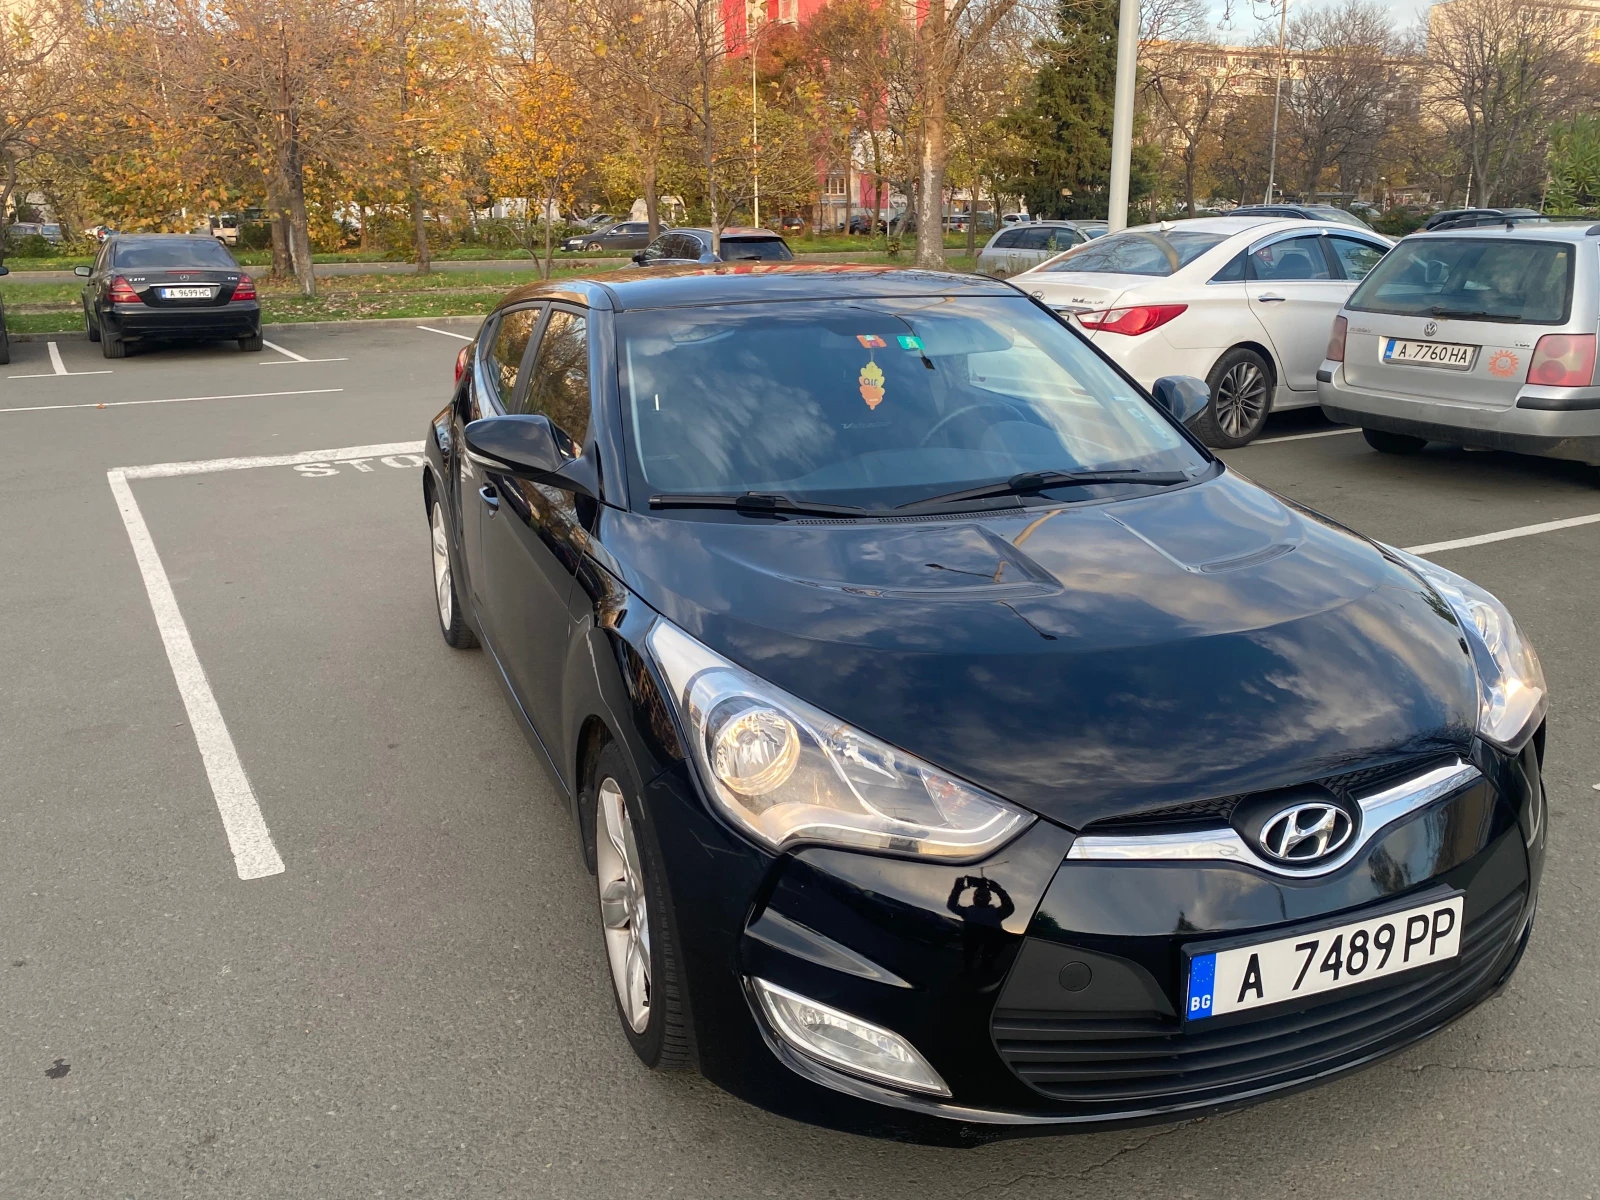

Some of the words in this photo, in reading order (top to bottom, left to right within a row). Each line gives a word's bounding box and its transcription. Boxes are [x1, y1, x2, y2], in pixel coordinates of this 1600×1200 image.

[293, 455, 423, 477] STO
[1237, 952, 1264, 1004] A
[1291, 923, 1396, 992] 7489
[1190, 994, 1211, 1012] BG
